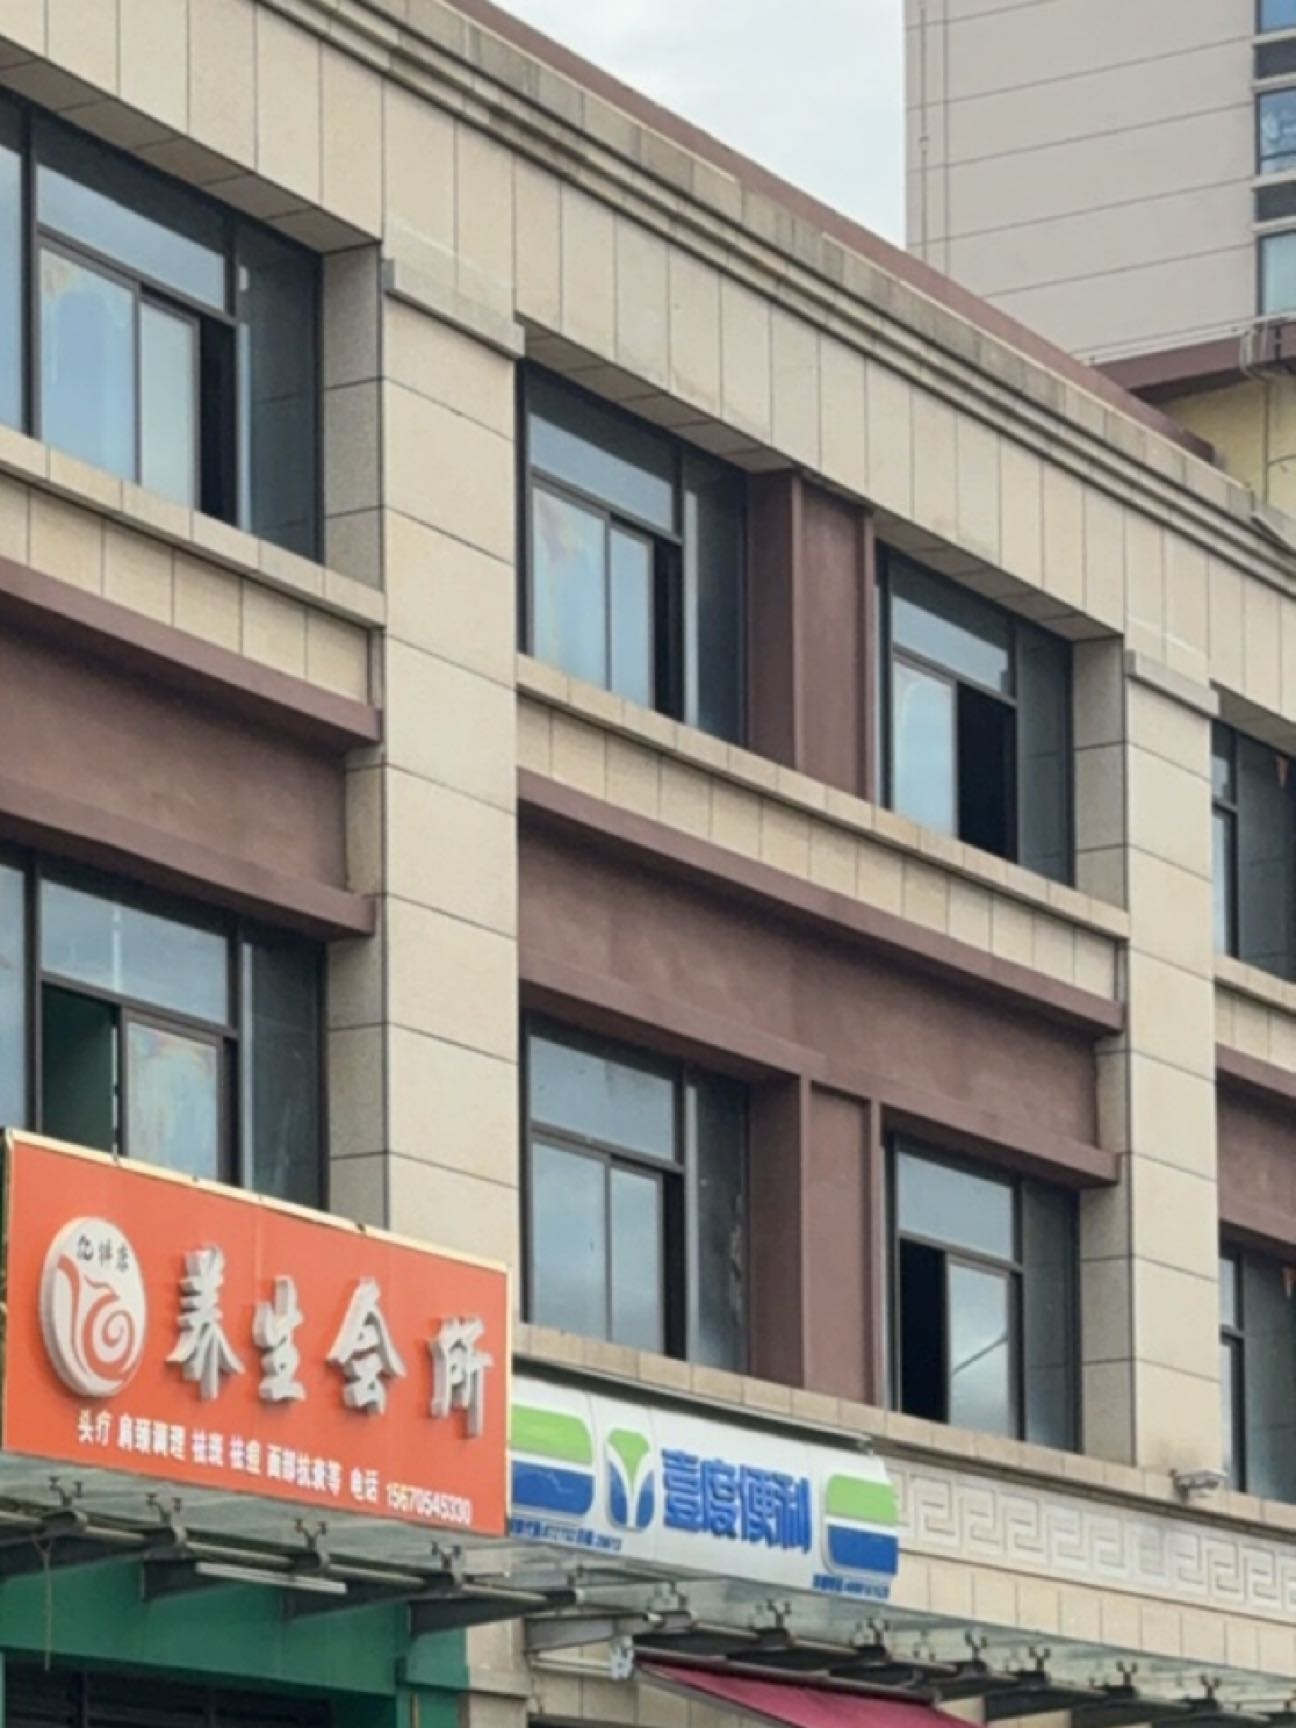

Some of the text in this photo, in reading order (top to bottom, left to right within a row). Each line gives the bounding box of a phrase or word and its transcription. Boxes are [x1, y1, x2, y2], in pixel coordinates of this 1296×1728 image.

[164, 1243, 494, 1438] 养生会所
[350, 1466, 378, 1504] 电话
